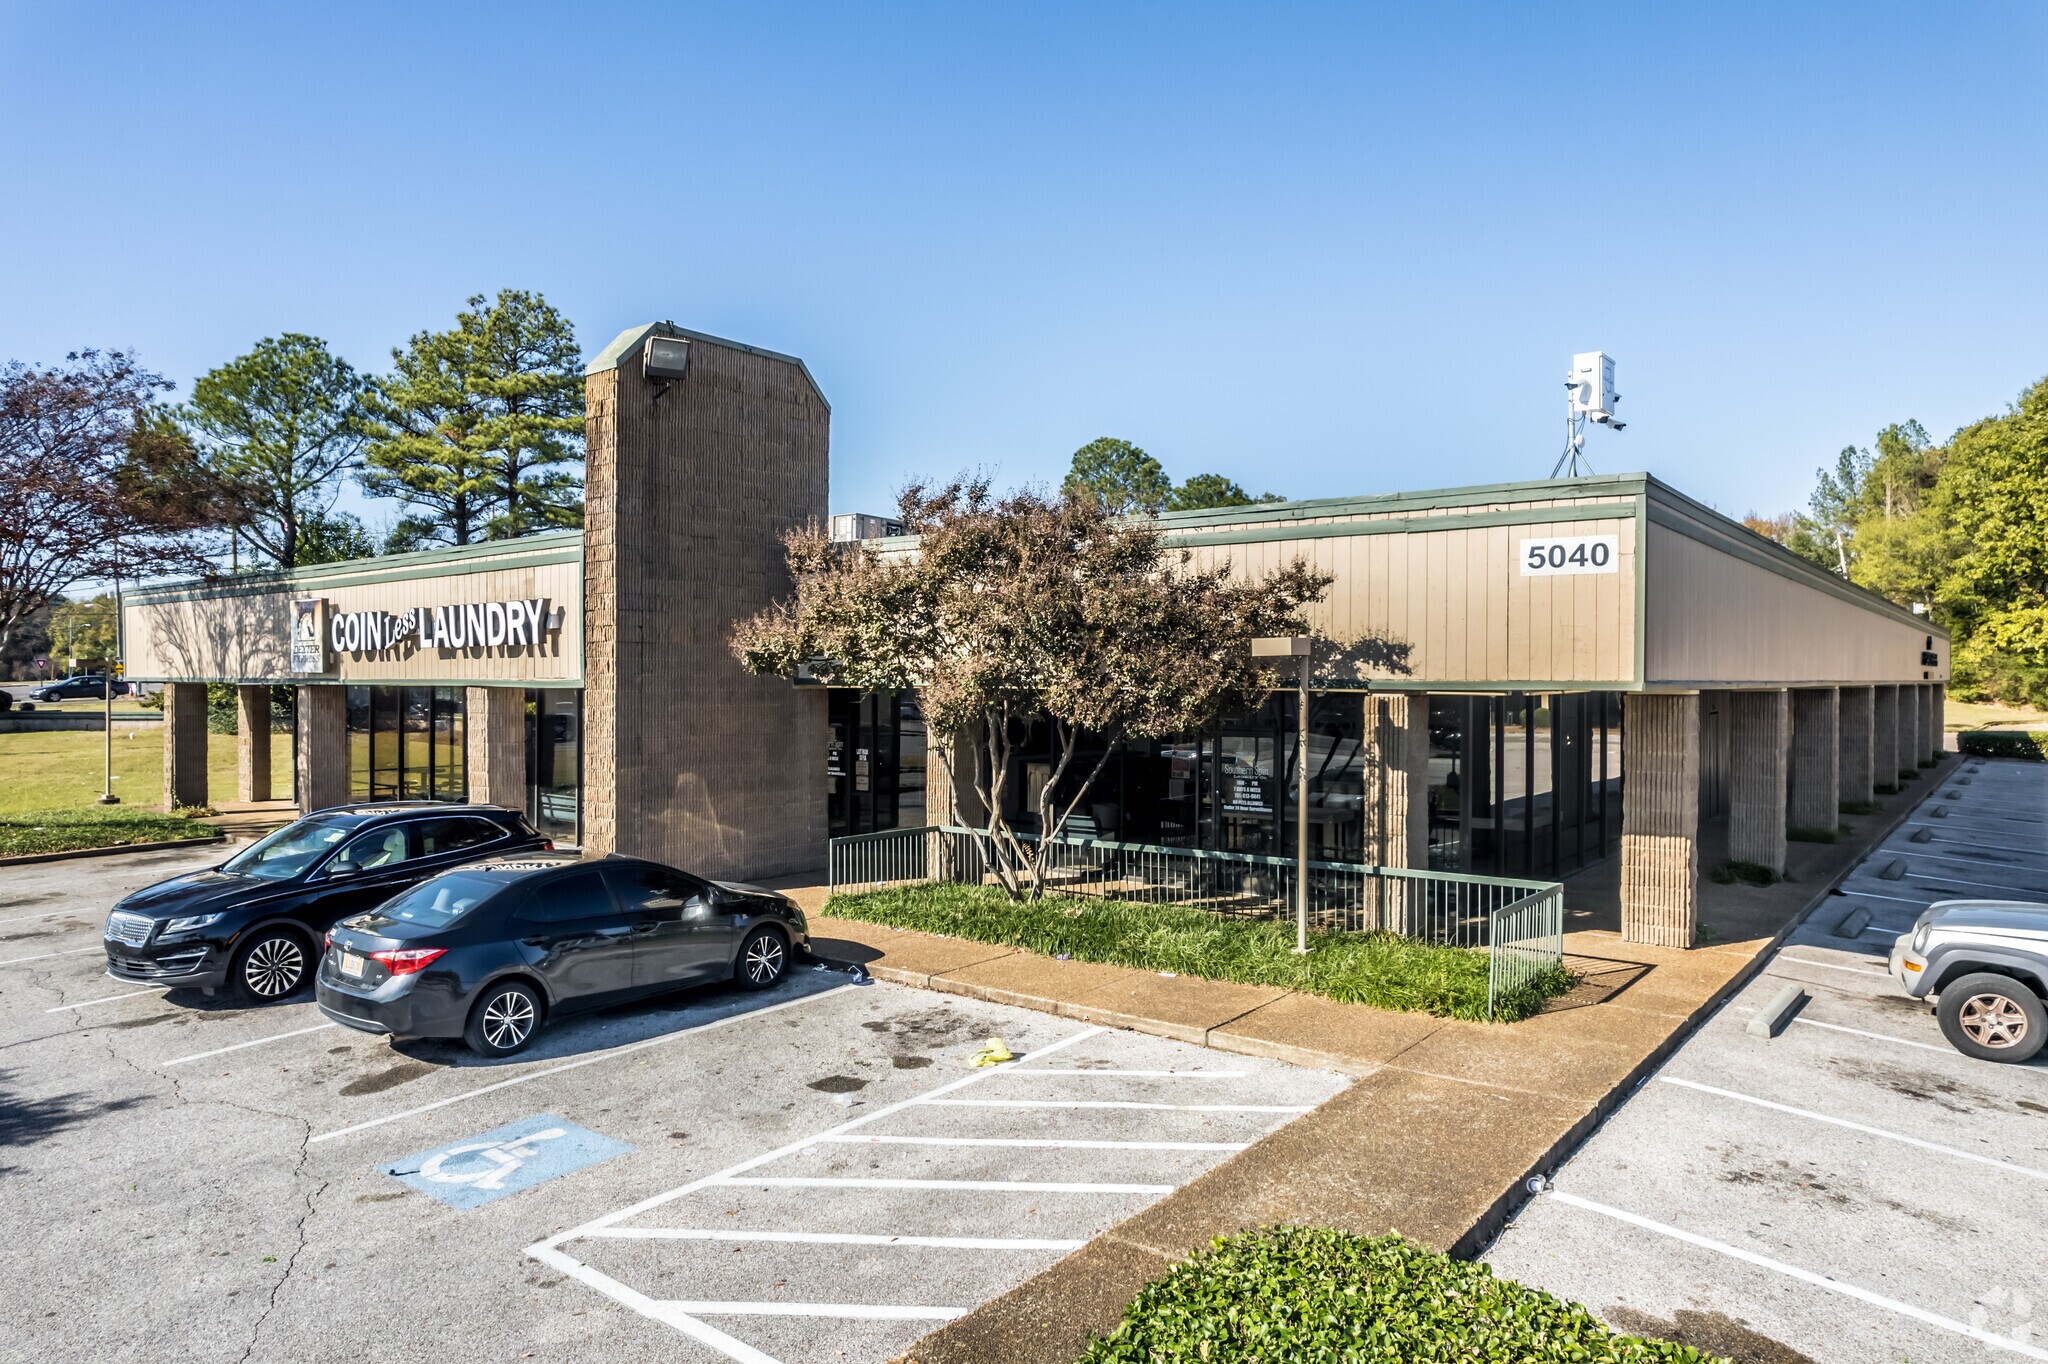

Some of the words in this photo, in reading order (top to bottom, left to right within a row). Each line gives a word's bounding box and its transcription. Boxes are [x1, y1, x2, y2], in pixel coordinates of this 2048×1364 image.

[1528, 543, 1609, 569] 5040
[331, 611, 381, 652] COIN
[384, 608, 416, 649] Less
[418, 598, 544, 648] LAUNDRY
[294, 645, 320, 654] DEXTER
